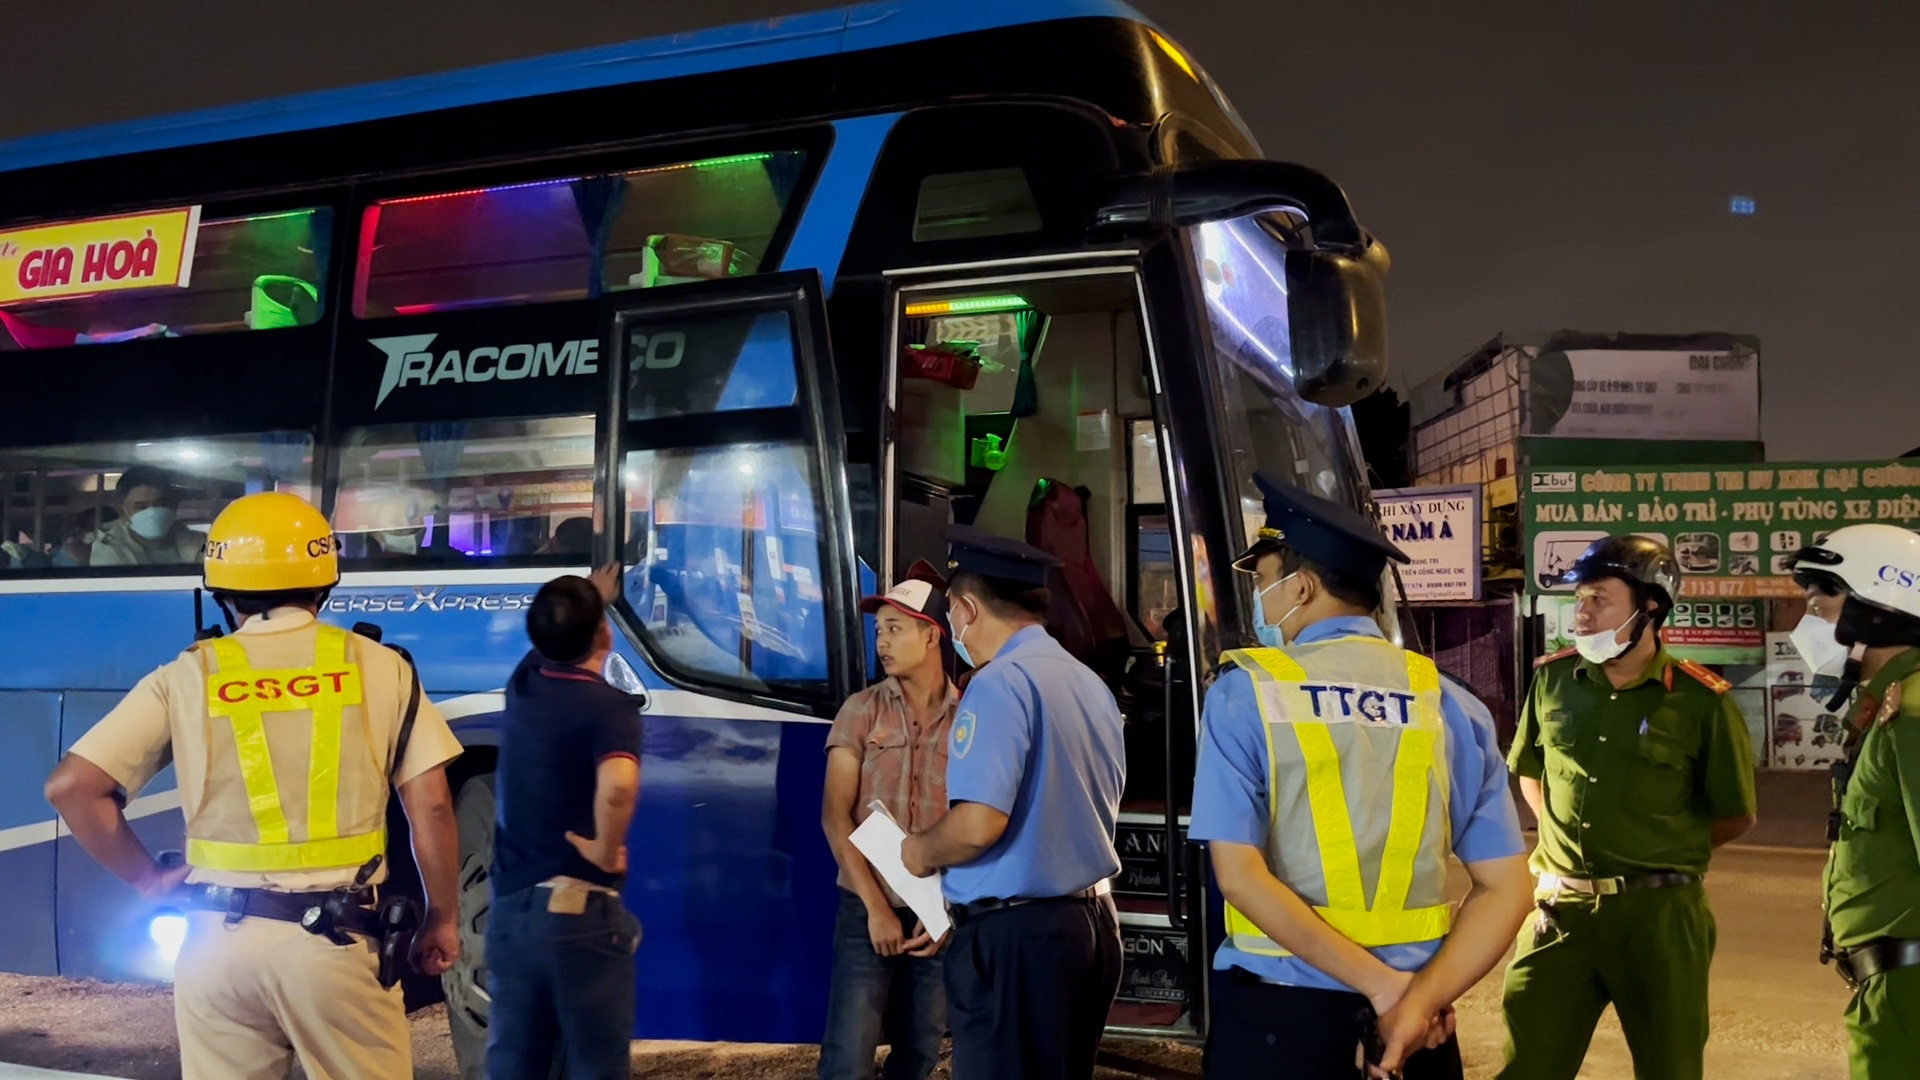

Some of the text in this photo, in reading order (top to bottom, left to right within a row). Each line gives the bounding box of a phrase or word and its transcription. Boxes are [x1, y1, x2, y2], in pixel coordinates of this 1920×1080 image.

[18, 229, 158, 289] GIA HOÀ
[1634, 472, 1657, 491] TY
[1428, 499, 1465, 515] DỰNG
[1535, 503, 1578, 522] MUA
[1582, 498, 1622, 522] BÁN
[1637, 495, 1679, 522] BẢO
[1682, 497, 1717, 522] TRÌ
[1732, 501, 1774, 525] PHỤ
[1779, 496, 1838, 520] TÙNG
[1843, 499, 1871, 520] XE
[1392, 521, 1435, 541] NAM
[1689, 580, 1715, 595] 113
[1877, 564, 1920, 593] CS
[218, 671, 350, 704] CSGT
[1299, 685, 1415, 724] TTGT
